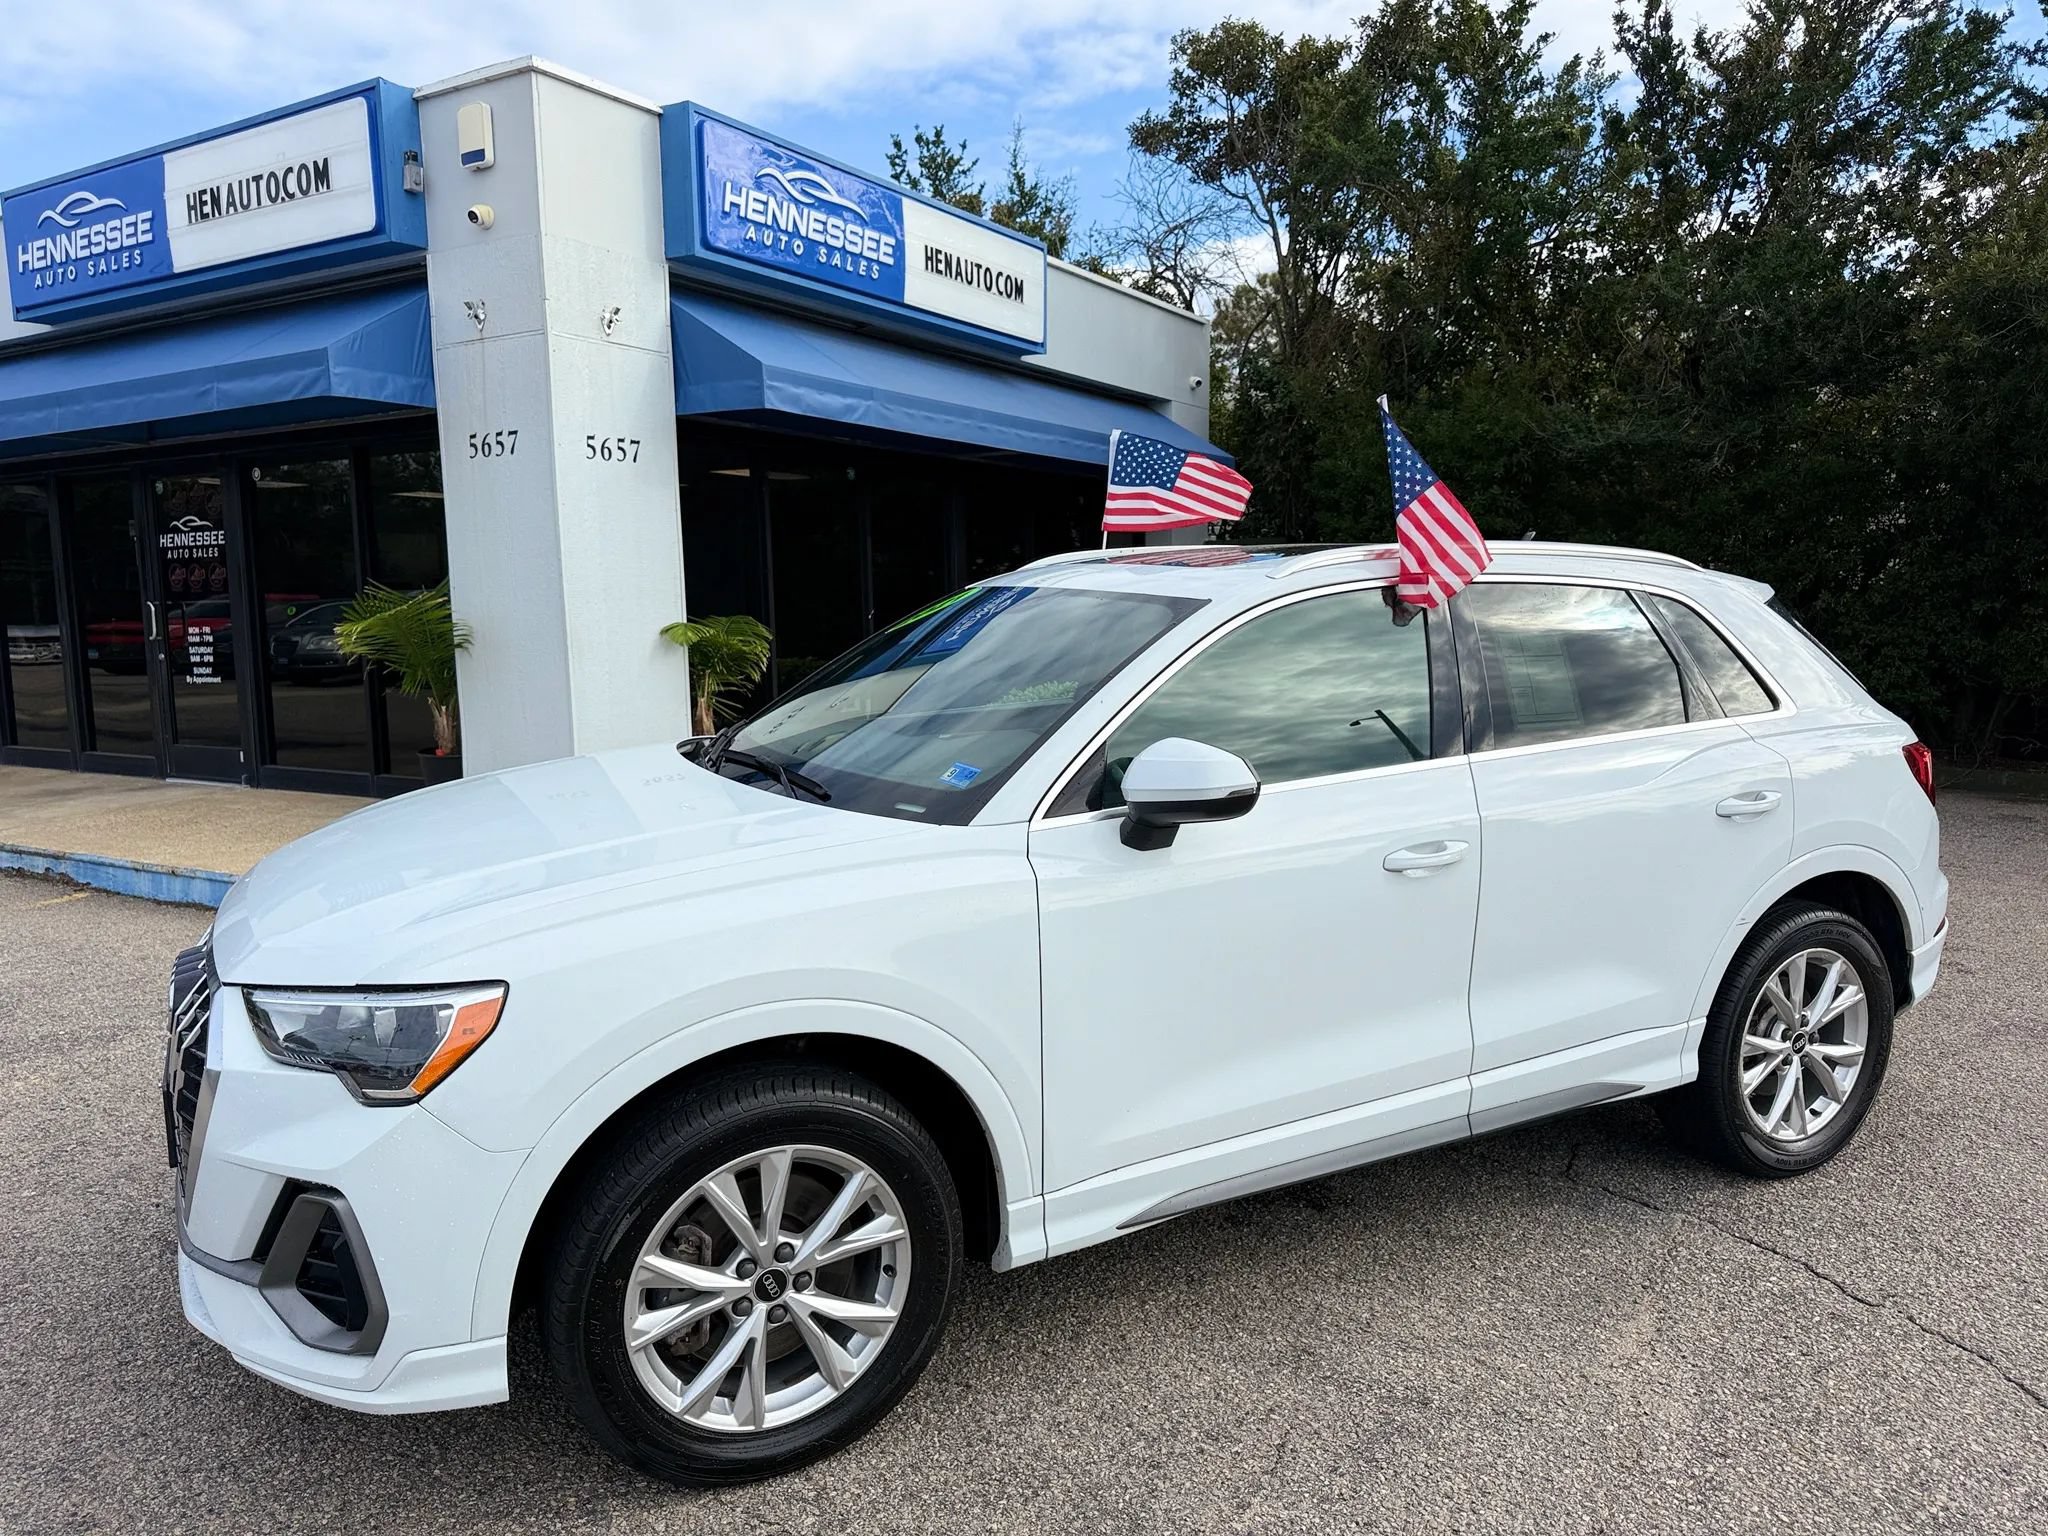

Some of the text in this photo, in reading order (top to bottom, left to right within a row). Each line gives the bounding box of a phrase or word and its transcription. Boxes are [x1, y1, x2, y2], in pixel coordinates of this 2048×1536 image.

[186, 157, 332, 225] HENAUTO.COM
[723, 180, 896, 266] HENNESSEE
[18, 210, 153, 273] HENNESSEE
[745, 225, 880, 280] AUTO SALES
[34, 249, 142, 289] AUTO SALES
[469, 429, 519, 459] 5657
[586, 434, 641, 463] 5657
[159, 530, 226, 548] HENNESSEE
[167, 547, 219, 559] AUTO SALES
[188, 646, 214, 654] SATURDAY
[193, 666, 213, 675] SUNDAY
[193, 675, 222, 685] Appointment
